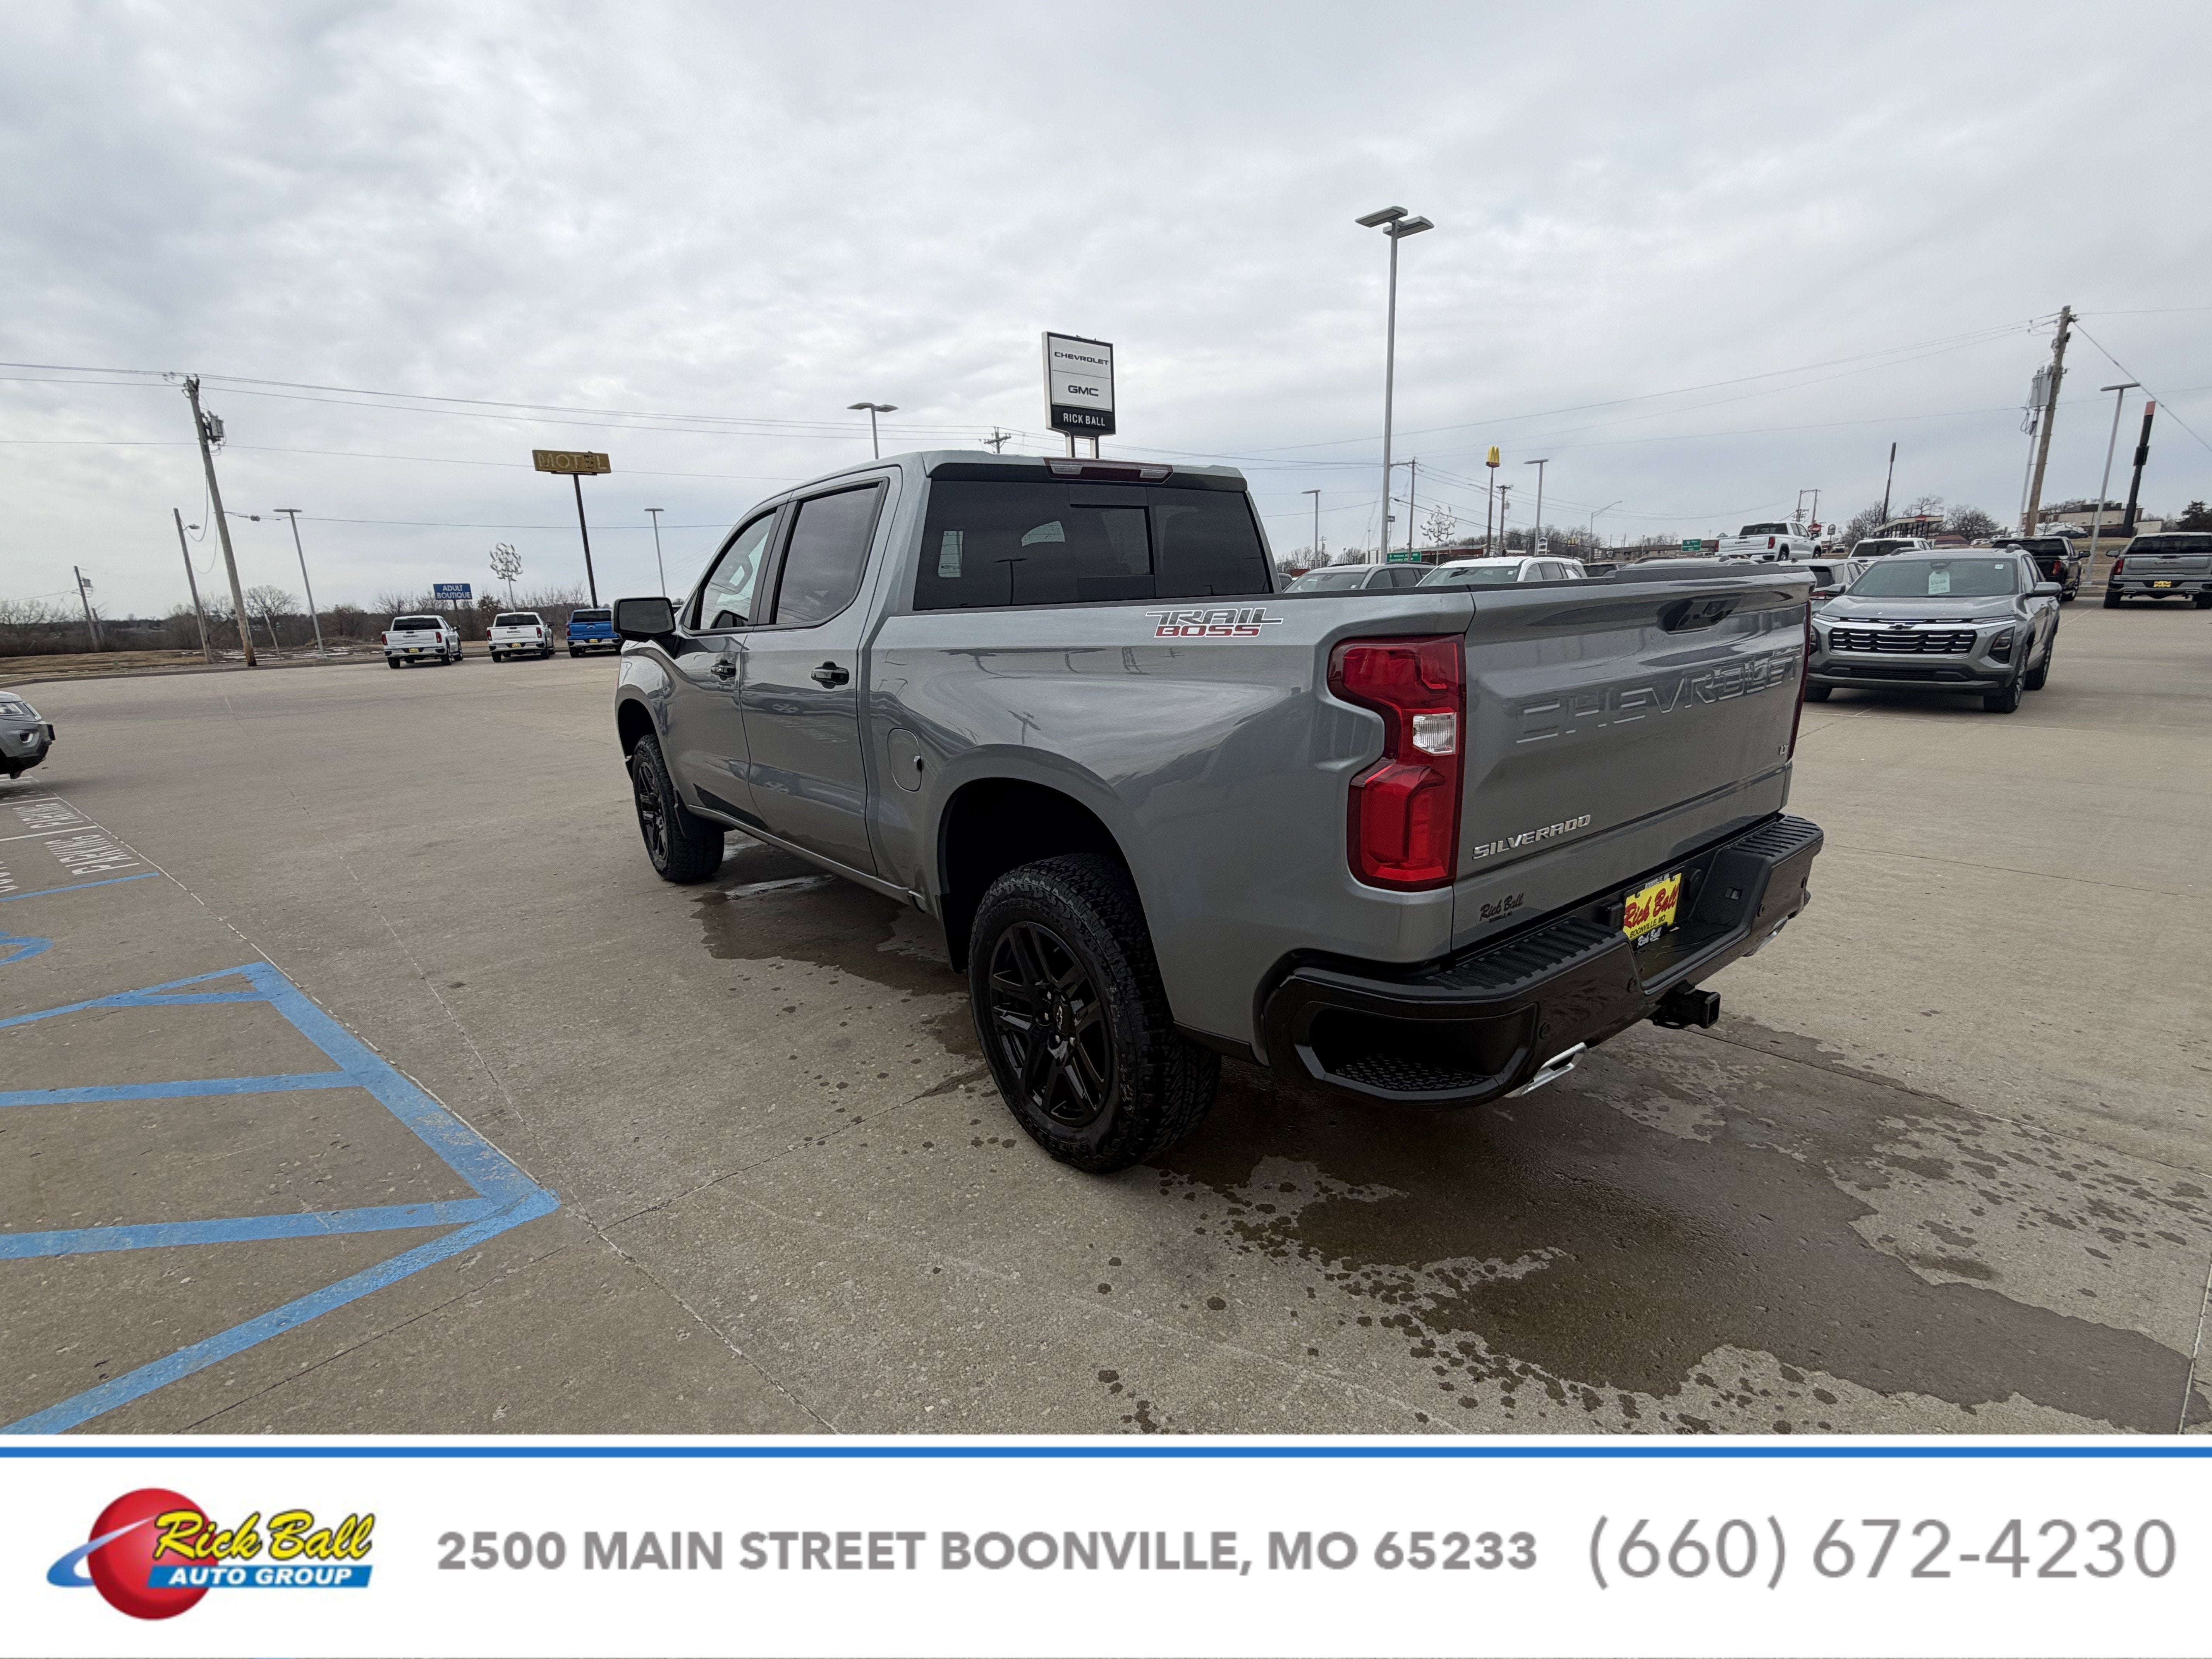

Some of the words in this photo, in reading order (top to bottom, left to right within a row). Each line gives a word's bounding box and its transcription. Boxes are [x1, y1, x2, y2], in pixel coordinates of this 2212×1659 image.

[1054, 351, 1109, 365] CHEVROLET
[1068, 385, 1099, 397] GMC
[1063, 413, 1084, 424] RICK
[1085, 416, 1106, 426] BALL
[1145, 607, 1284, 625] TRAIL
[1154, 624, 1264, 638] BOSS
[1513, 652, 1801, 744] CHEVROLET
[1472, 814, 1591, 860] SILVERADO
[44, 835, 140, 875] PARKING
[1479, 898, 1502, 922] Rick
[1503, 892, 1524, 912] Ball
[1623, 895, 1652, 929] Rick
[1653, 884, 1680, 917] Ball
[1630, 919, 1657, 938] BOONVILLE
